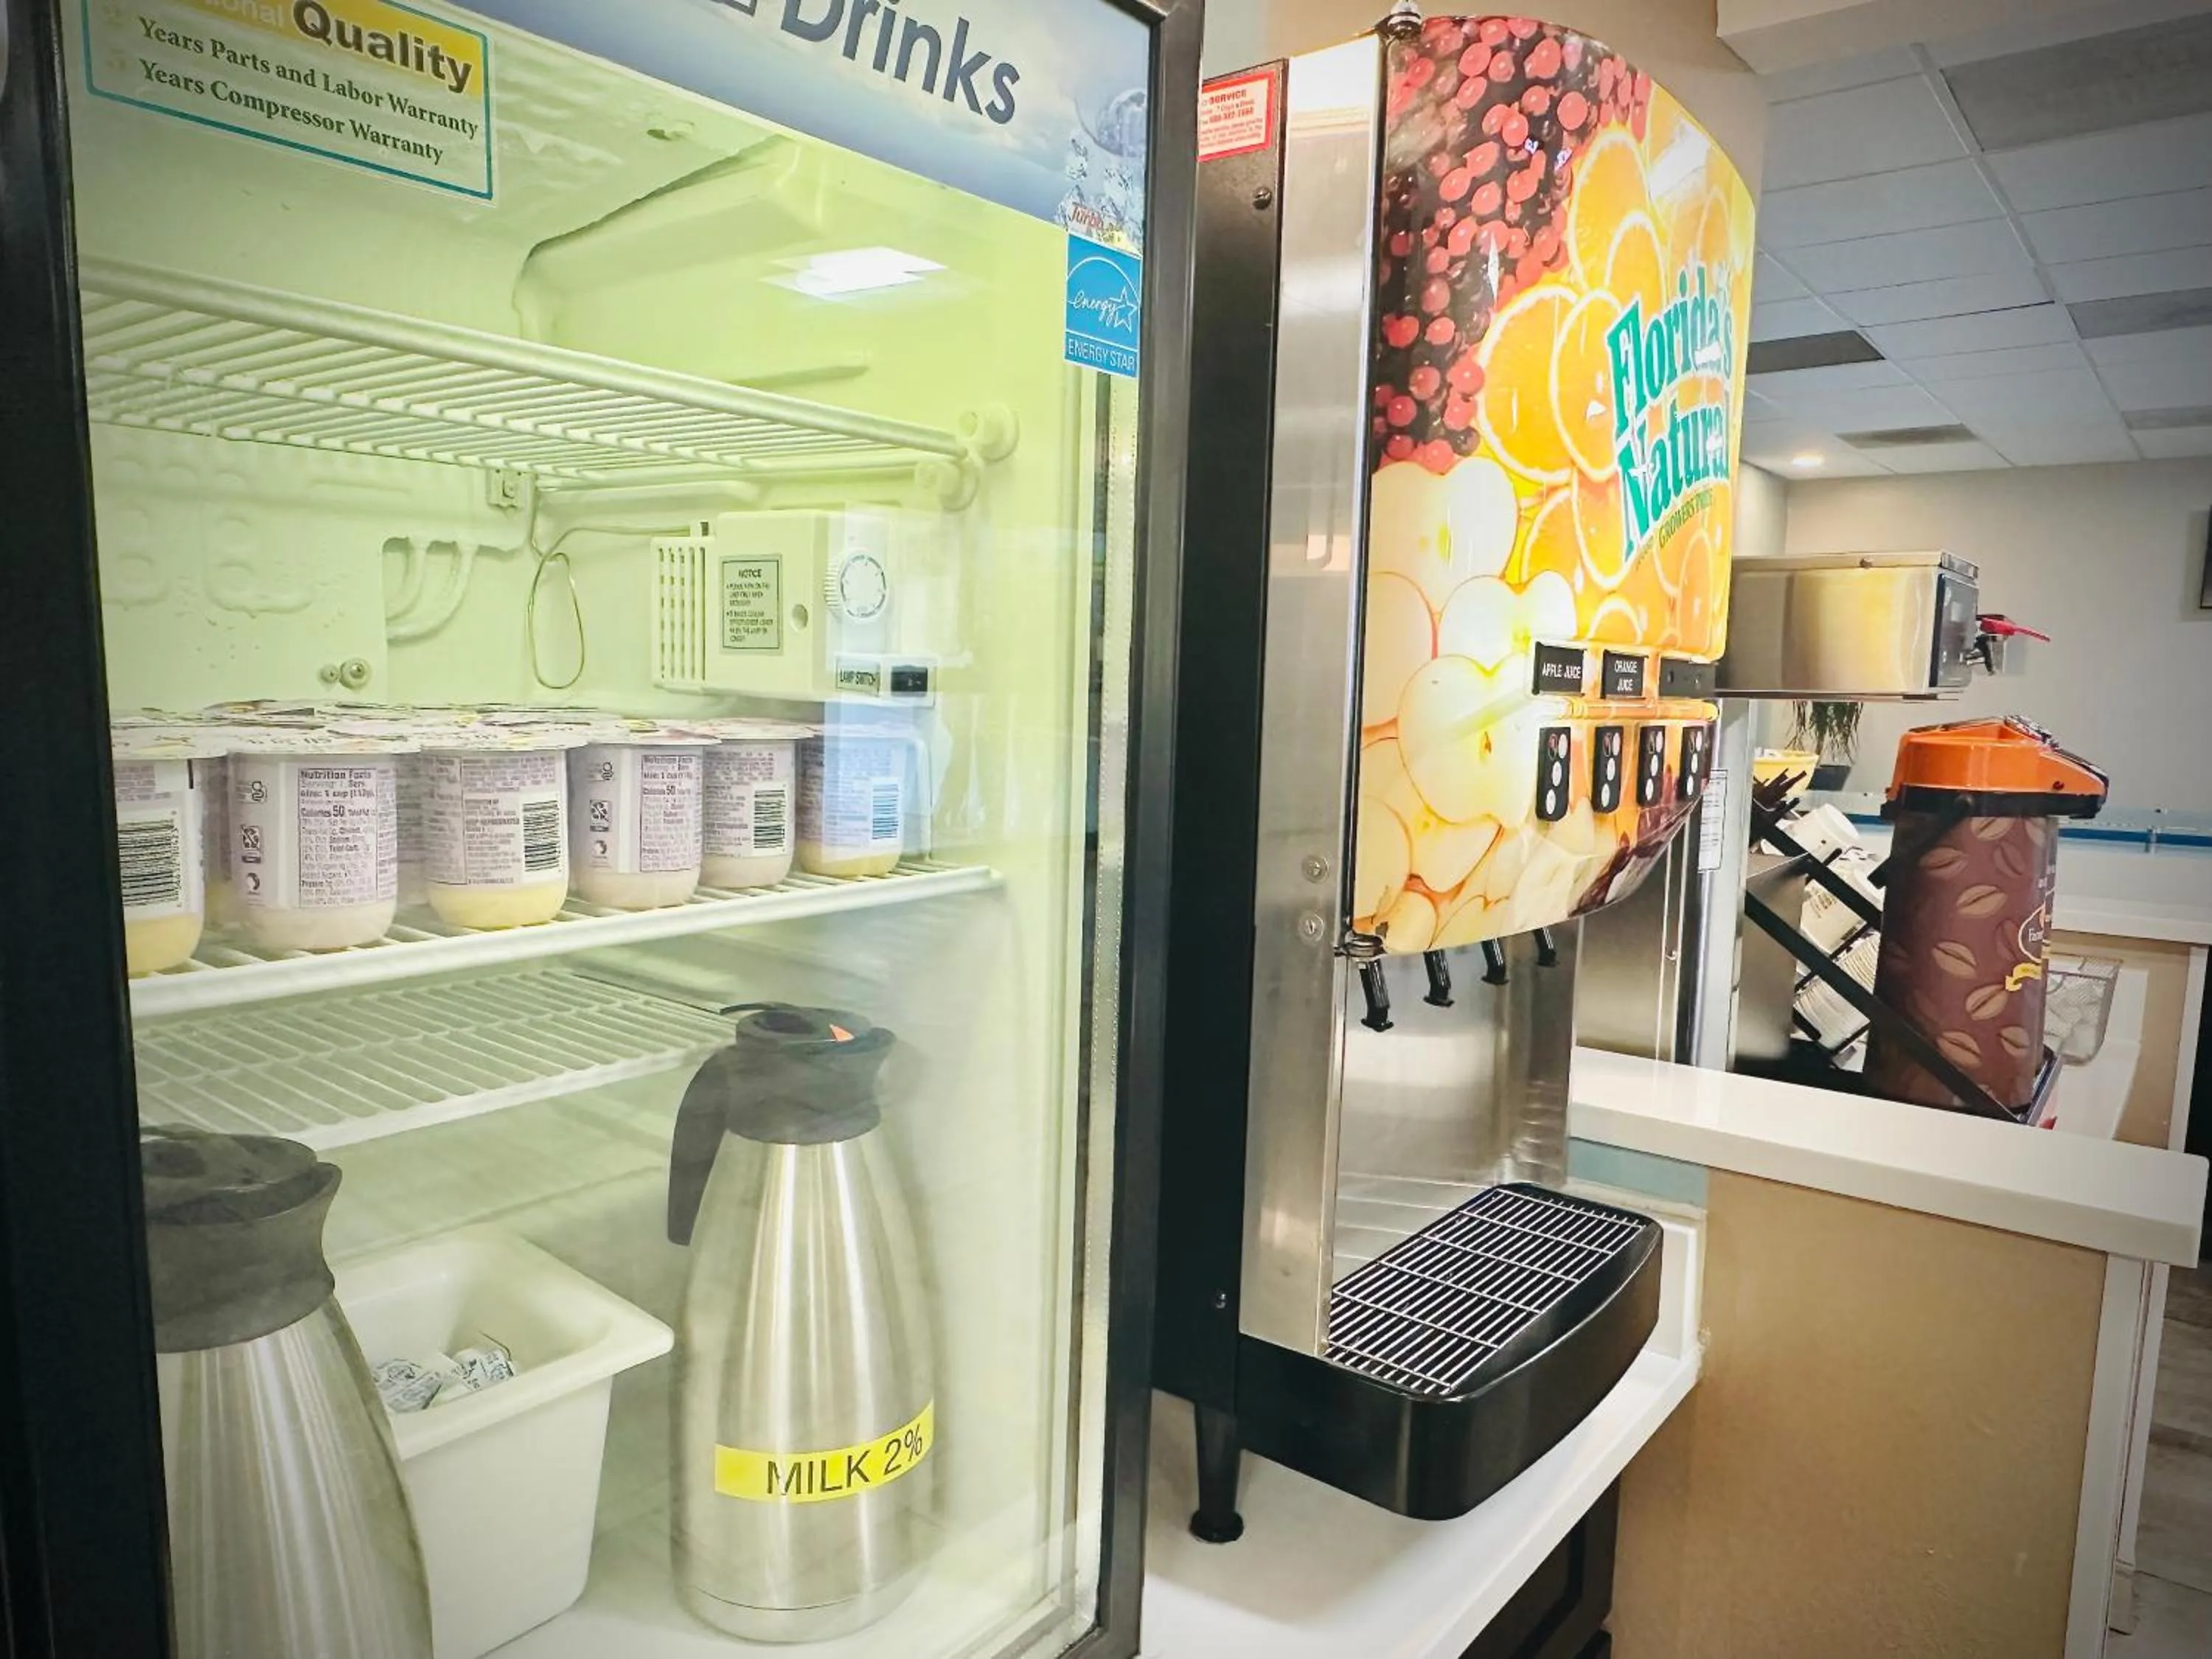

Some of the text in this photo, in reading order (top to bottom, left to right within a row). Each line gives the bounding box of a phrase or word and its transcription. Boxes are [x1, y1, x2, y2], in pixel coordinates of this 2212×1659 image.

[293, 0, 473, 94] Quality
[139, 16, 478, 140] Years Parts and Labor Warranty
[139, 58, 204, 94] Years
[211, 81, 345, 134] Compressor
[349, 118, 444, 165] Warranty
[1068, 289, 1116, 327] energy
[1068, 338, 1135, 371] ENERGY STAR
[1543, 662, 1582, 679] APPLE JUICE
[1614, 660, 1638, 673] ORANGE
[1617, 678, 1633, 692] JUICE
[300, 771, 346, 779] Nutrition
[765, 1423, 923, 1497] MILK 2%
